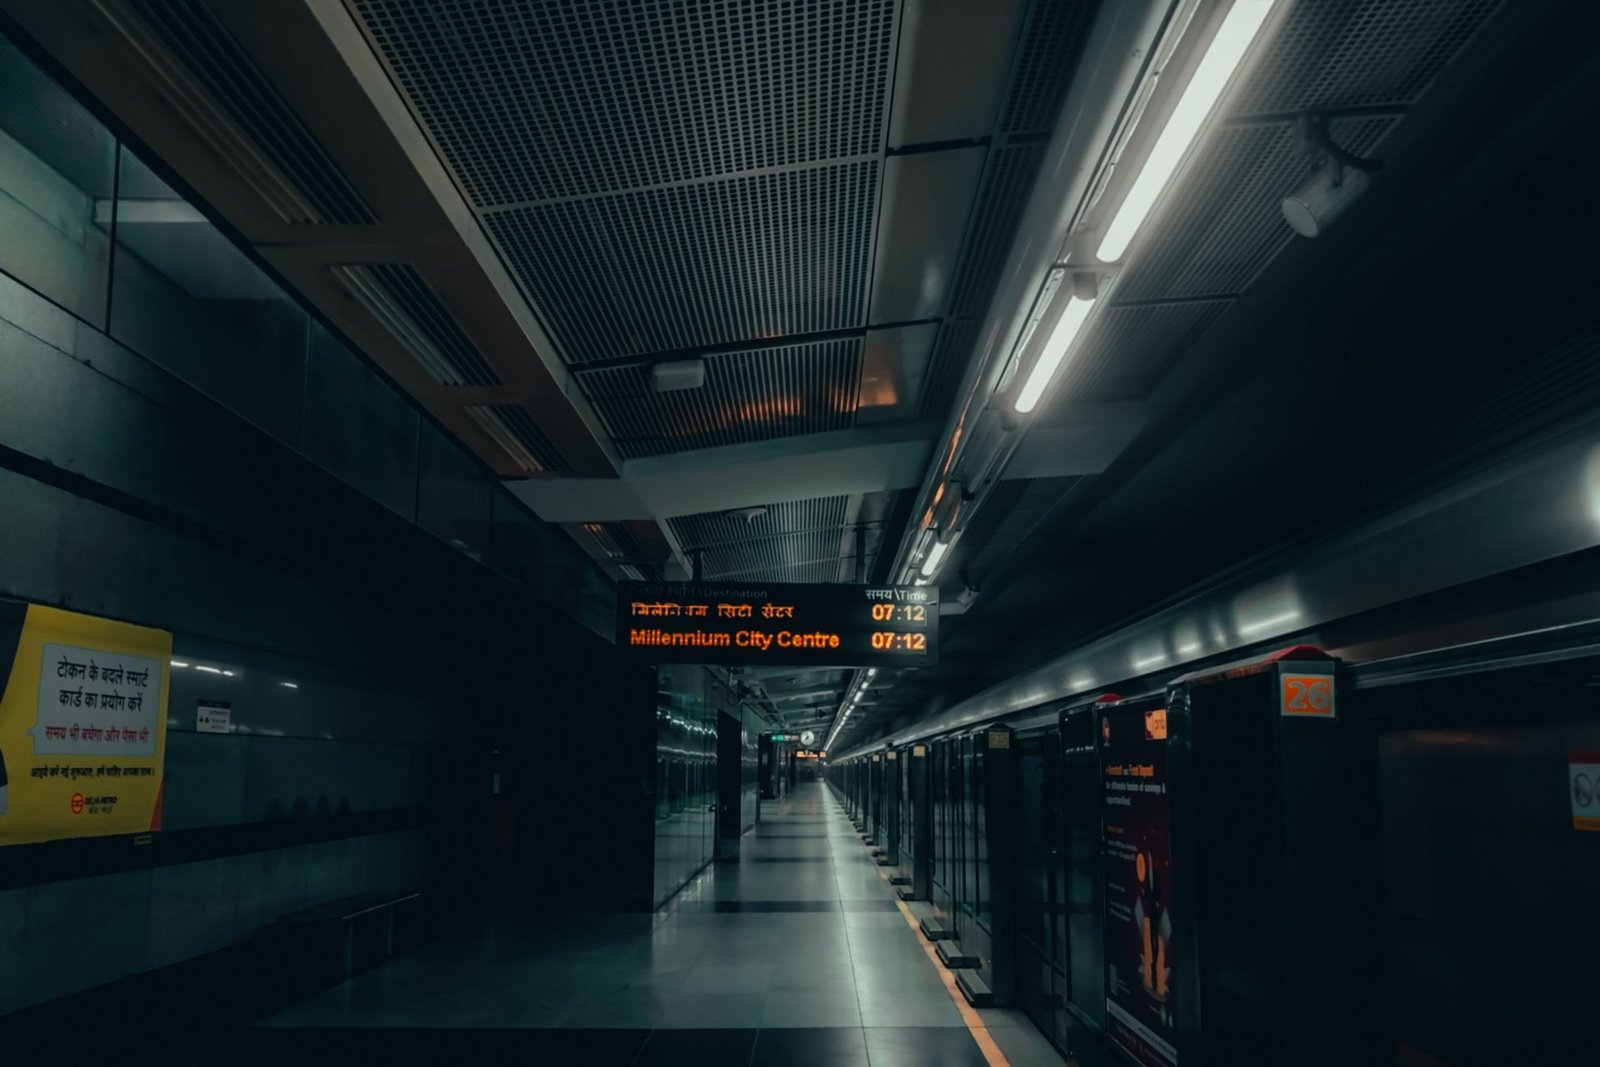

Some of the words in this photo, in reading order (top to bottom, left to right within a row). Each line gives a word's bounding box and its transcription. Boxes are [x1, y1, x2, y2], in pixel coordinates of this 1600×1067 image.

[717, 603, 753, 619] सिटी
[871, 604, 926, 622] 07:12
[630, 629, 732, 647] Millennium
[735, 631, 773, 651] City
[777, 632, 841, 651] Centre
[871, 632, 926, 650] 07:12
[57, 656, 86, 680] टोकन
[89, 660, 99, 681] के
[101, 664, 123, 684] बदले
[126, 668, 149, 687] स्मार्ट
[59, 686, 83, 707] कार्ड
[84, 692, 98, 708] का
[100, 690, 126, 710] प्रयोग
[128, 692, 143, 712] करें
[1287, 681, 1328, 709] 26
[46, 726, 66, 740] समय
[69, 723, 79, 741] भी
[104, 726, 120, 742] और
